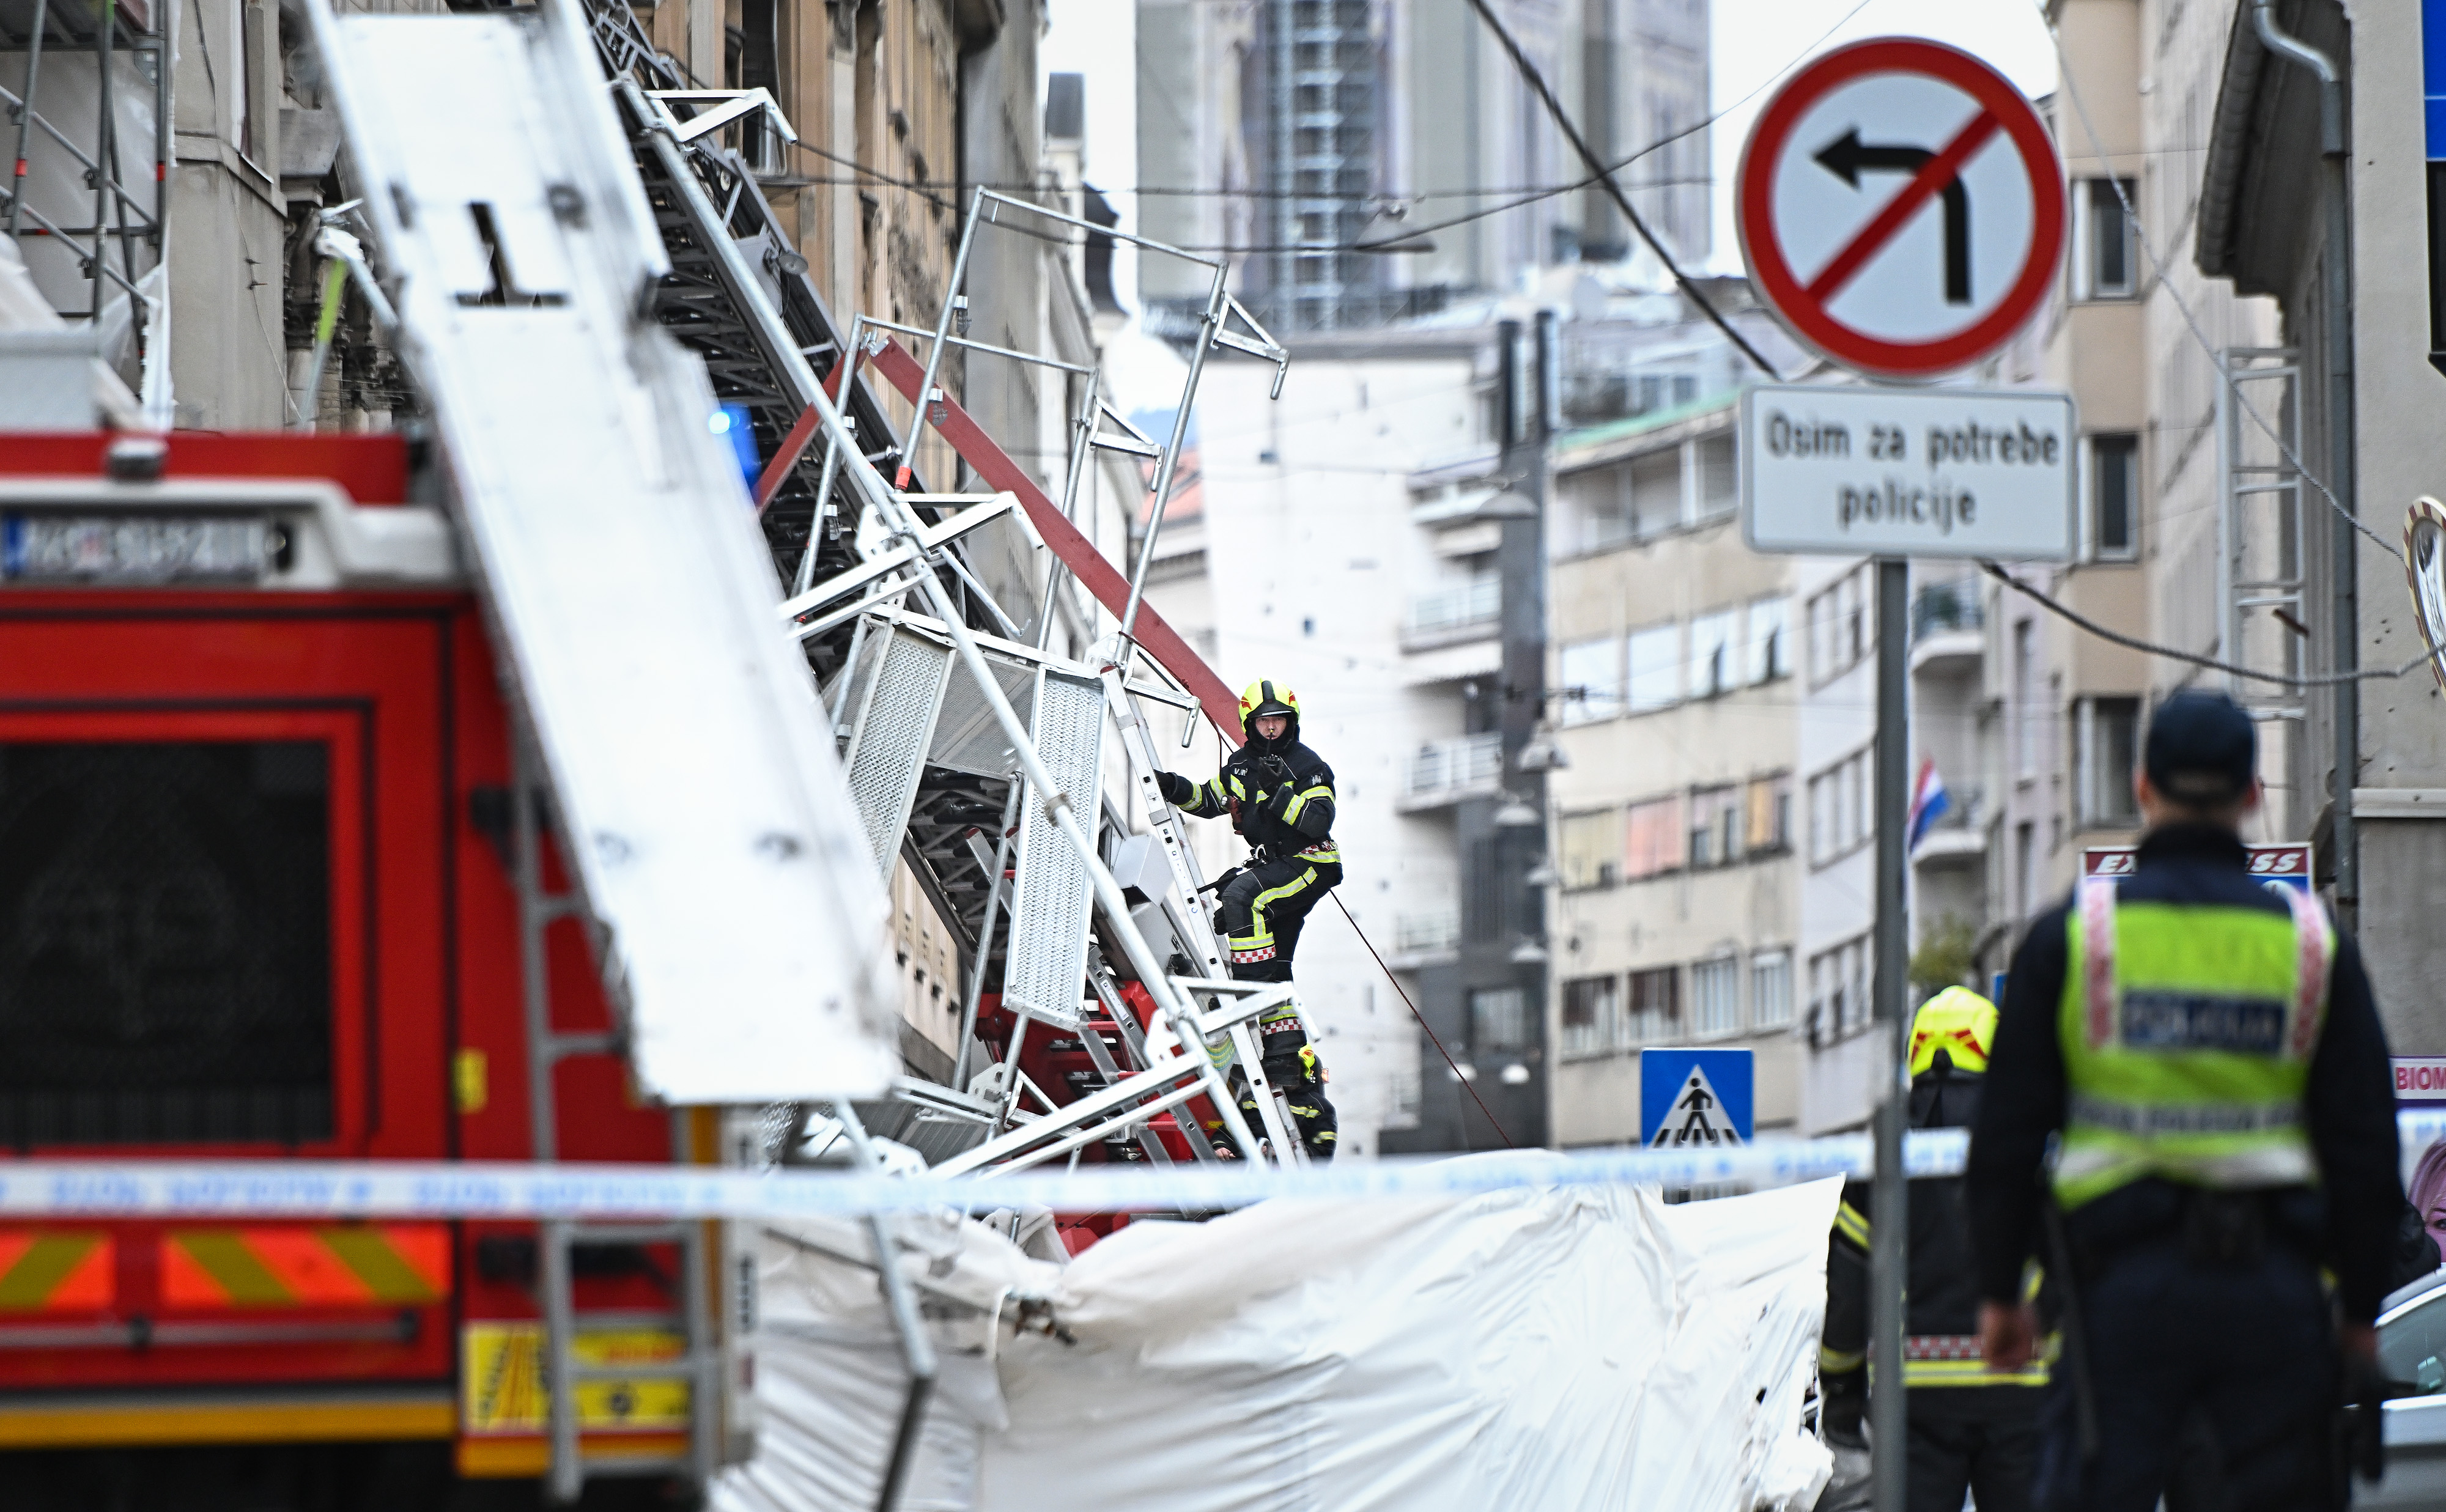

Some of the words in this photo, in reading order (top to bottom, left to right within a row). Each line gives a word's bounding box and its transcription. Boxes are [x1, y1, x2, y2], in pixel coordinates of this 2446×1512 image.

[1765, 411, 1851, 459] Osim
[1868, 424, 1907, 462] za
[1926, 416, 2060, 470] potrebe
[1839, 476, 1977, 535] policije
[2095, 852, 2302, 873] EXSS
